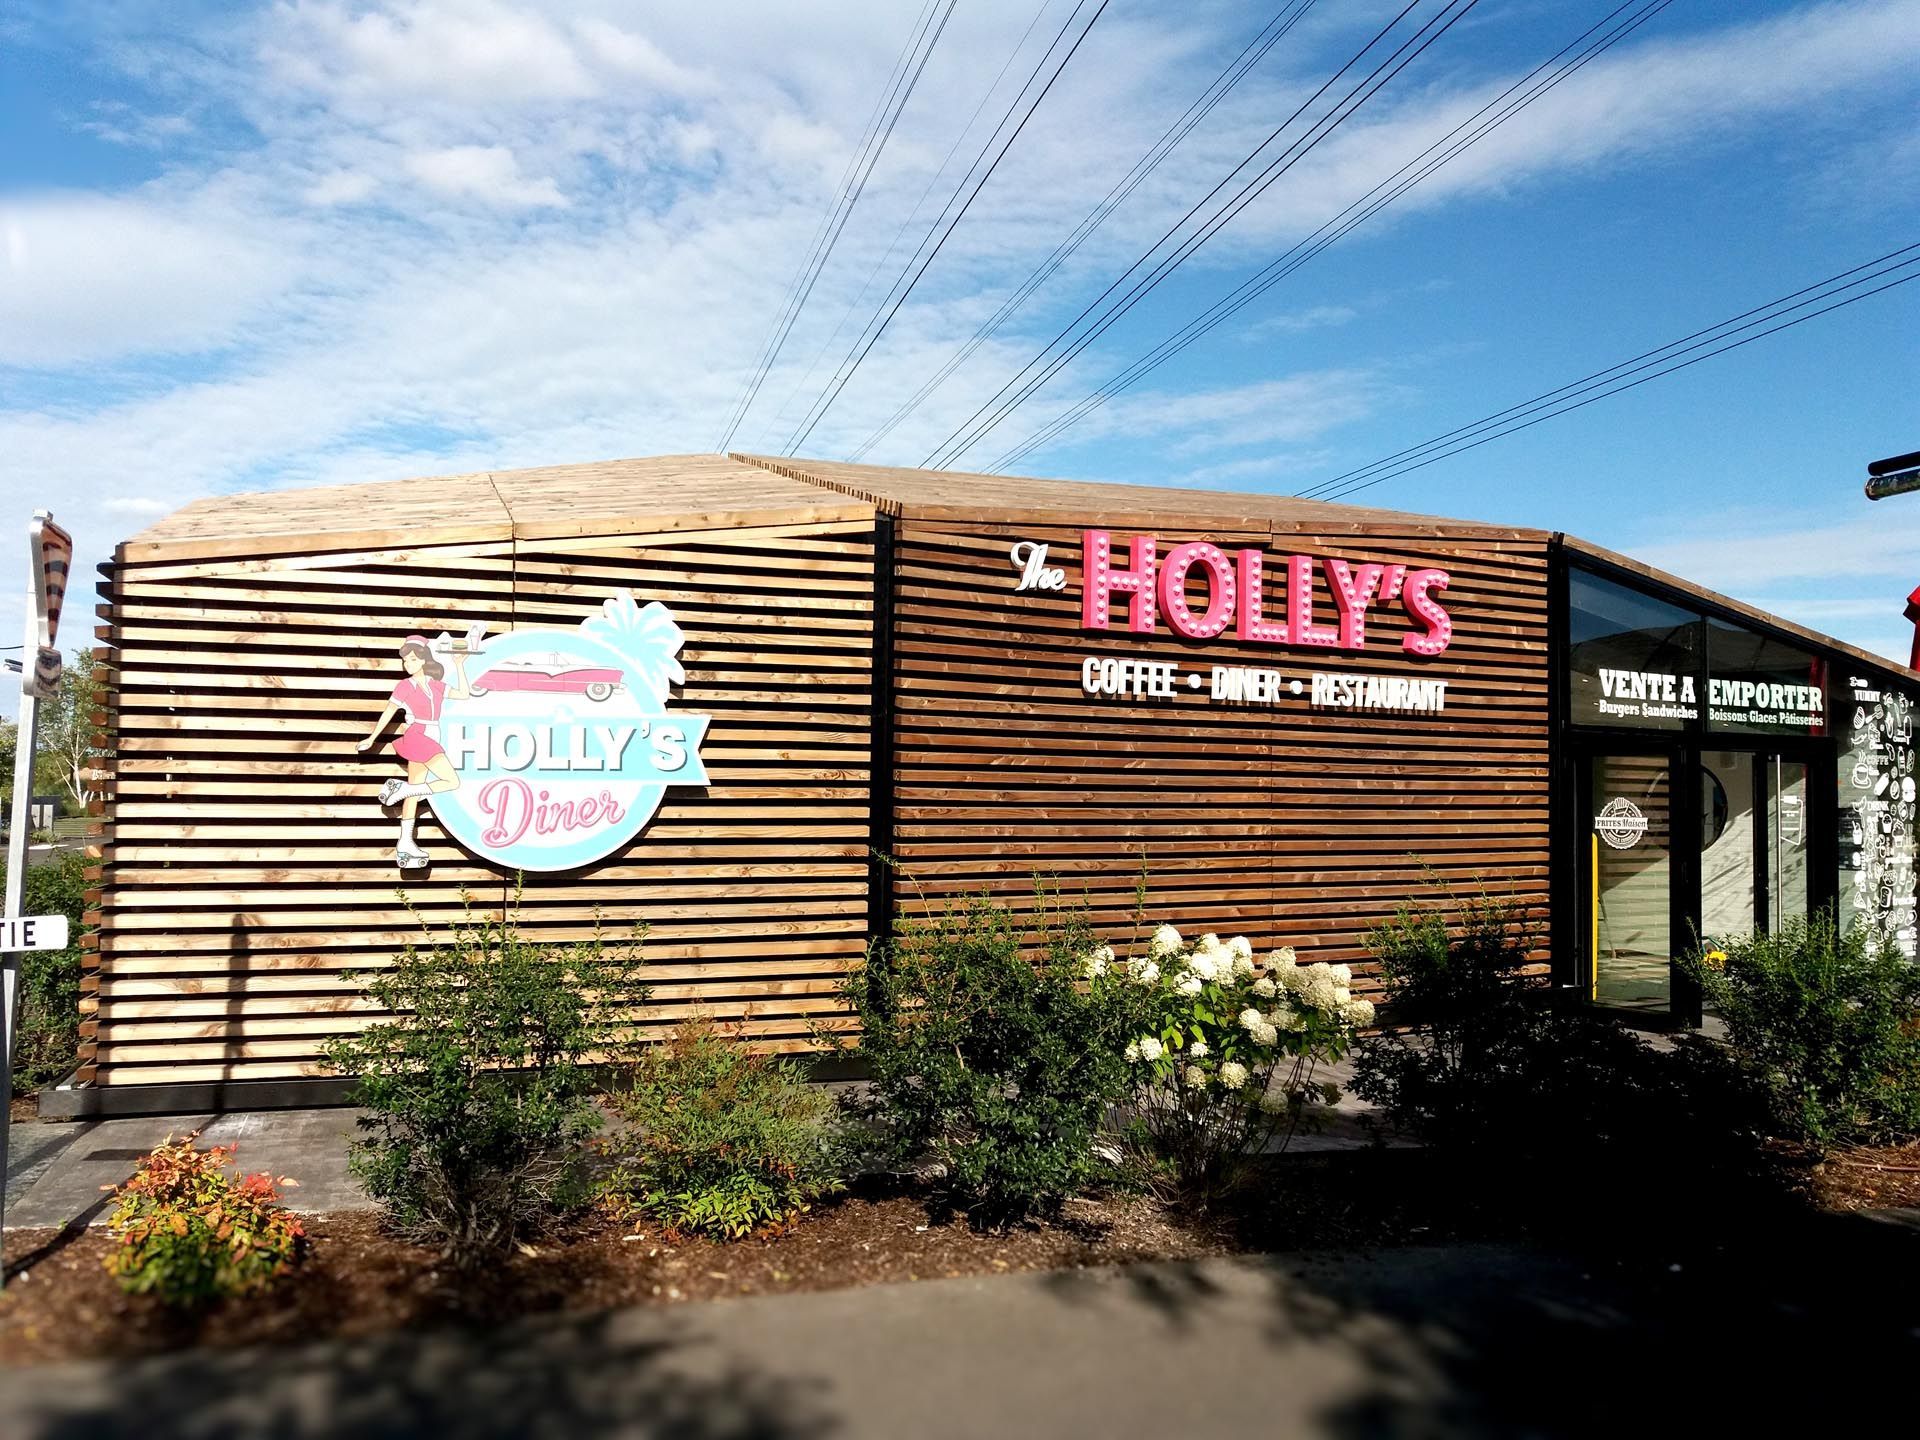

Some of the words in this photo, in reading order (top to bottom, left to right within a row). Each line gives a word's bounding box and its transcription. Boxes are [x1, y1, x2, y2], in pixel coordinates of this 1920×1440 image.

[1010, 541, 1067, 592] The
[1082, 529, 1453, 656] HOLLY'S
[1082, 657, 1178, 697] COFFEE
[1211, 666, 1281, 702] DINER
[1311, 673, 1448, 711] RESTAURANT
[1599, 669, 1676, 702] VENTE
[1681, 676, 1696, 703] A
[1709, 679, 1823, 711] EMPORTER
[1600, 699, 1640, 717] Burgers
[1642, 702, 1698, 719] Sandwiches
[1709, 708, 1747, 722] Boissons
[1749, 710, 1777, 724] Glaces
[1779, 711, 1824, 726] Pâtisseries
[449, 722, 688, 772] HOLLY'S
[478, 777, 626, 848] Diner
[1597, 819, 1621, 827] FRITES
